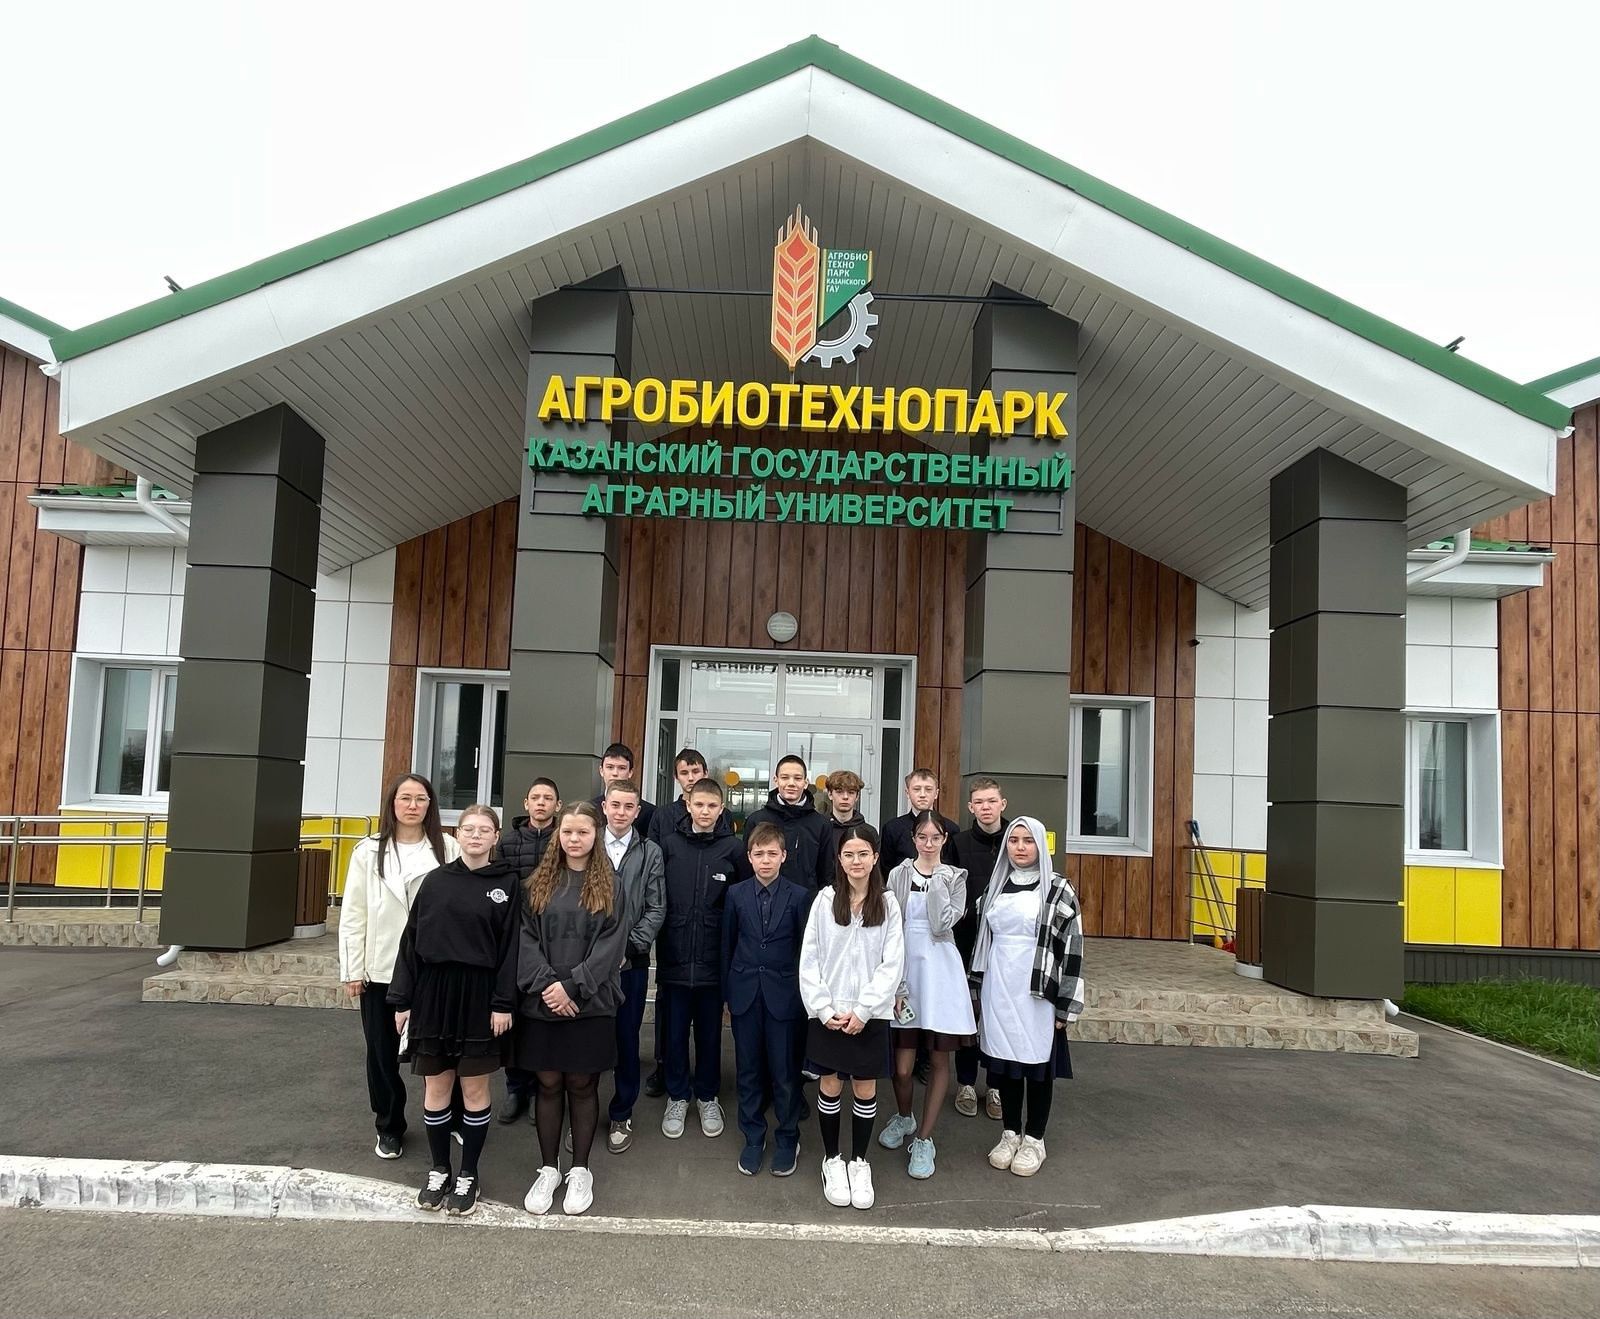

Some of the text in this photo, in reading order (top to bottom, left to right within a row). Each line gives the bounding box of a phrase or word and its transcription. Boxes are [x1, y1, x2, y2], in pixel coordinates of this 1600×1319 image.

[828, 252, 868, 261] АГРОБИО
[828, 260, 855, 269] ТЕХНО
[827, 269, 850, 277] ПАРК
[826, 278, 866, 286] КАЗАНСКОГО
[826, 284, 840, 293] ГАУ
[537, 374, 1069, 439] АГРОБИОТЕХНОПАРК
[528, 437, 1073, 490] КАЗАНСКИЙ ГОСУДАРСТВЕННЫЙ
[581, 483, 1014, 529] АГРАРНЫЙ УНИВЕРСИТЕТ
